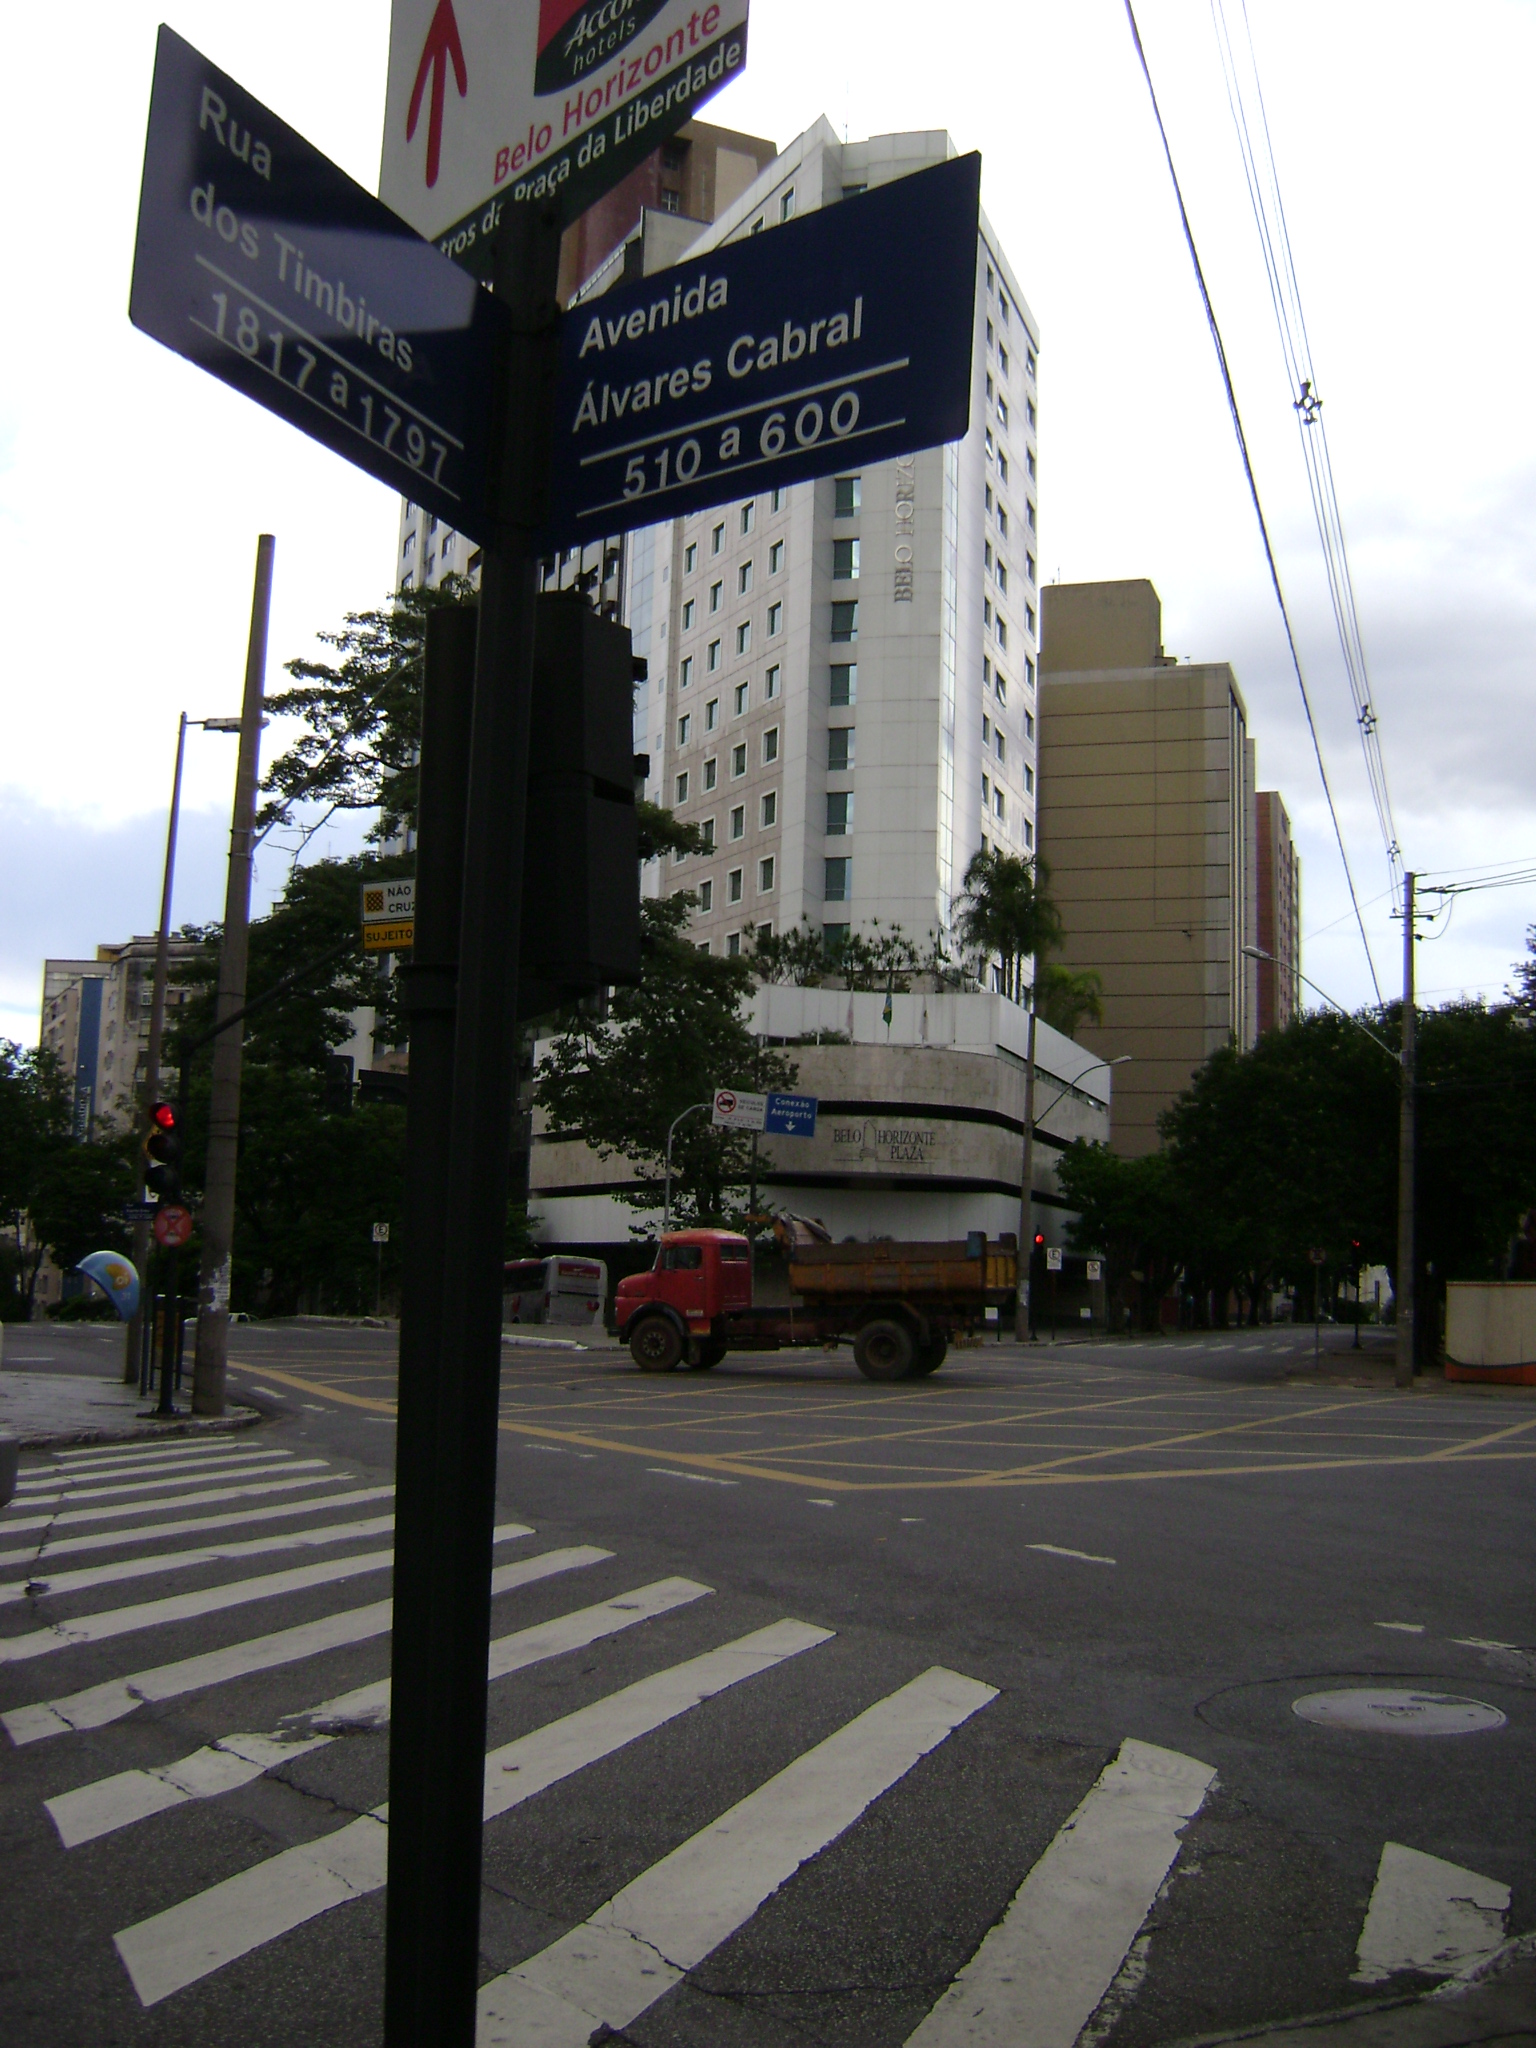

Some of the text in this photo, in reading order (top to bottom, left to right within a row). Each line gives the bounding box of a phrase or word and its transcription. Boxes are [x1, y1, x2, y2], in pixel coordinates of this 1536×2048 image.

[572, 16, 636, 75] hotels
[200, 86, 272, 181] Rua
[493, 3, 720, 186] Belo Horizonte
[514, 155, 571, 200] Praça
[577, 131, 606, 168] da
[614, 41, 740, 142] Liberdade
[191, 183, 414, 373] dos Timbiras
[579, 273, 729, 358] Avenida
[212, 292, 448, 484] 1817 a 1797
[572, 296, 863, 433] Álvares Cabral
[622, 391, 861, 500] 510 a 600
[894, 454, 915, 603] BELO HORIZO
[366, 929, 413, 942] SUJEITO
[388, 885, 411, 897] NÃO
[771, 1108, 813, 1120] Aeroporto
[775, 1097, 810, 1108] Conexão
[833, 1129, 936, 1146] BELO HORIZONTE
[890, 1146, 924, 1161] PLAZA
